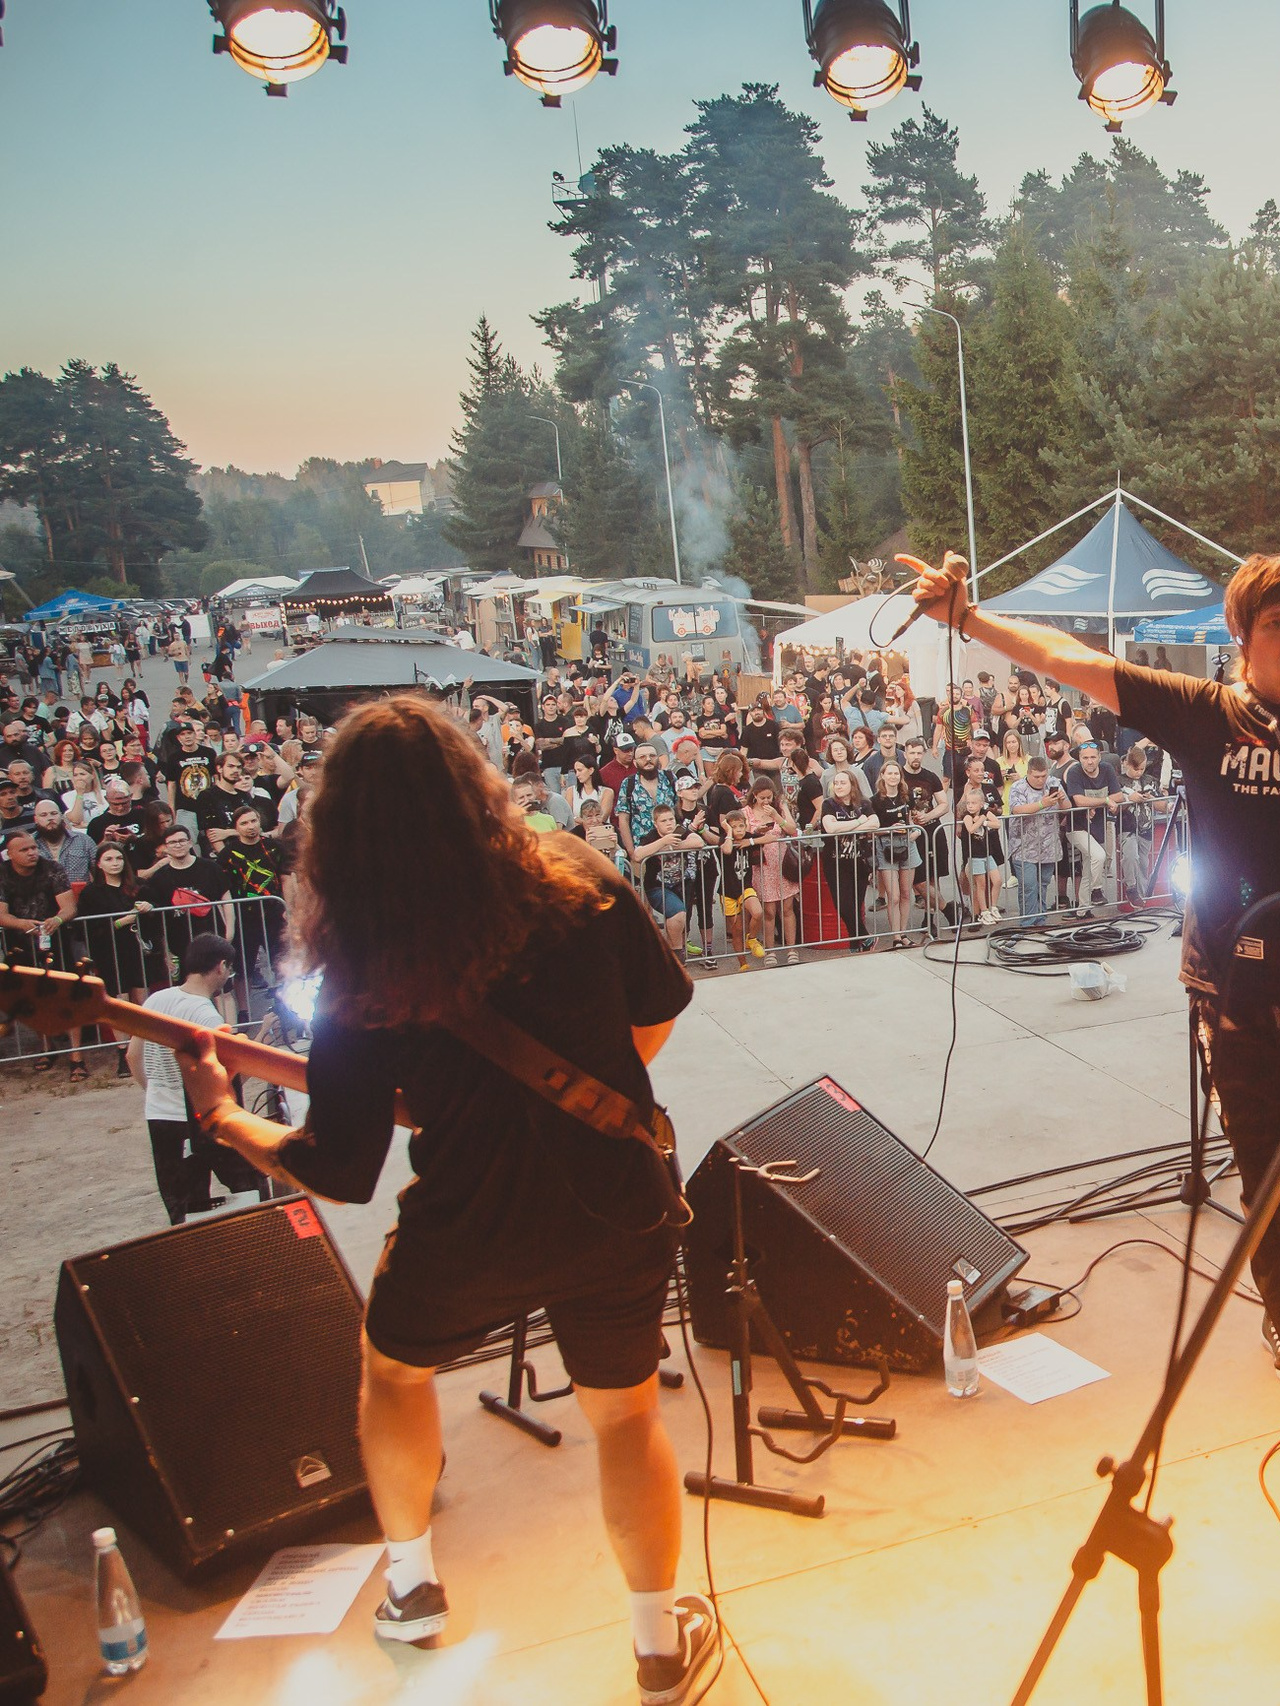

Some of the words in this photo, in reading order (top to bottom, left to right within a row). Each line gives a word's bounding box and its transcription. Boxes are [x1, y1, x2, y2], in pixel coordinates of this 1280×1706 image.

[250, 620, 279, 629] ВЫХОД
[1233, 783, 1258, 795] THE
[292, 1208, 310, 1226] 2
